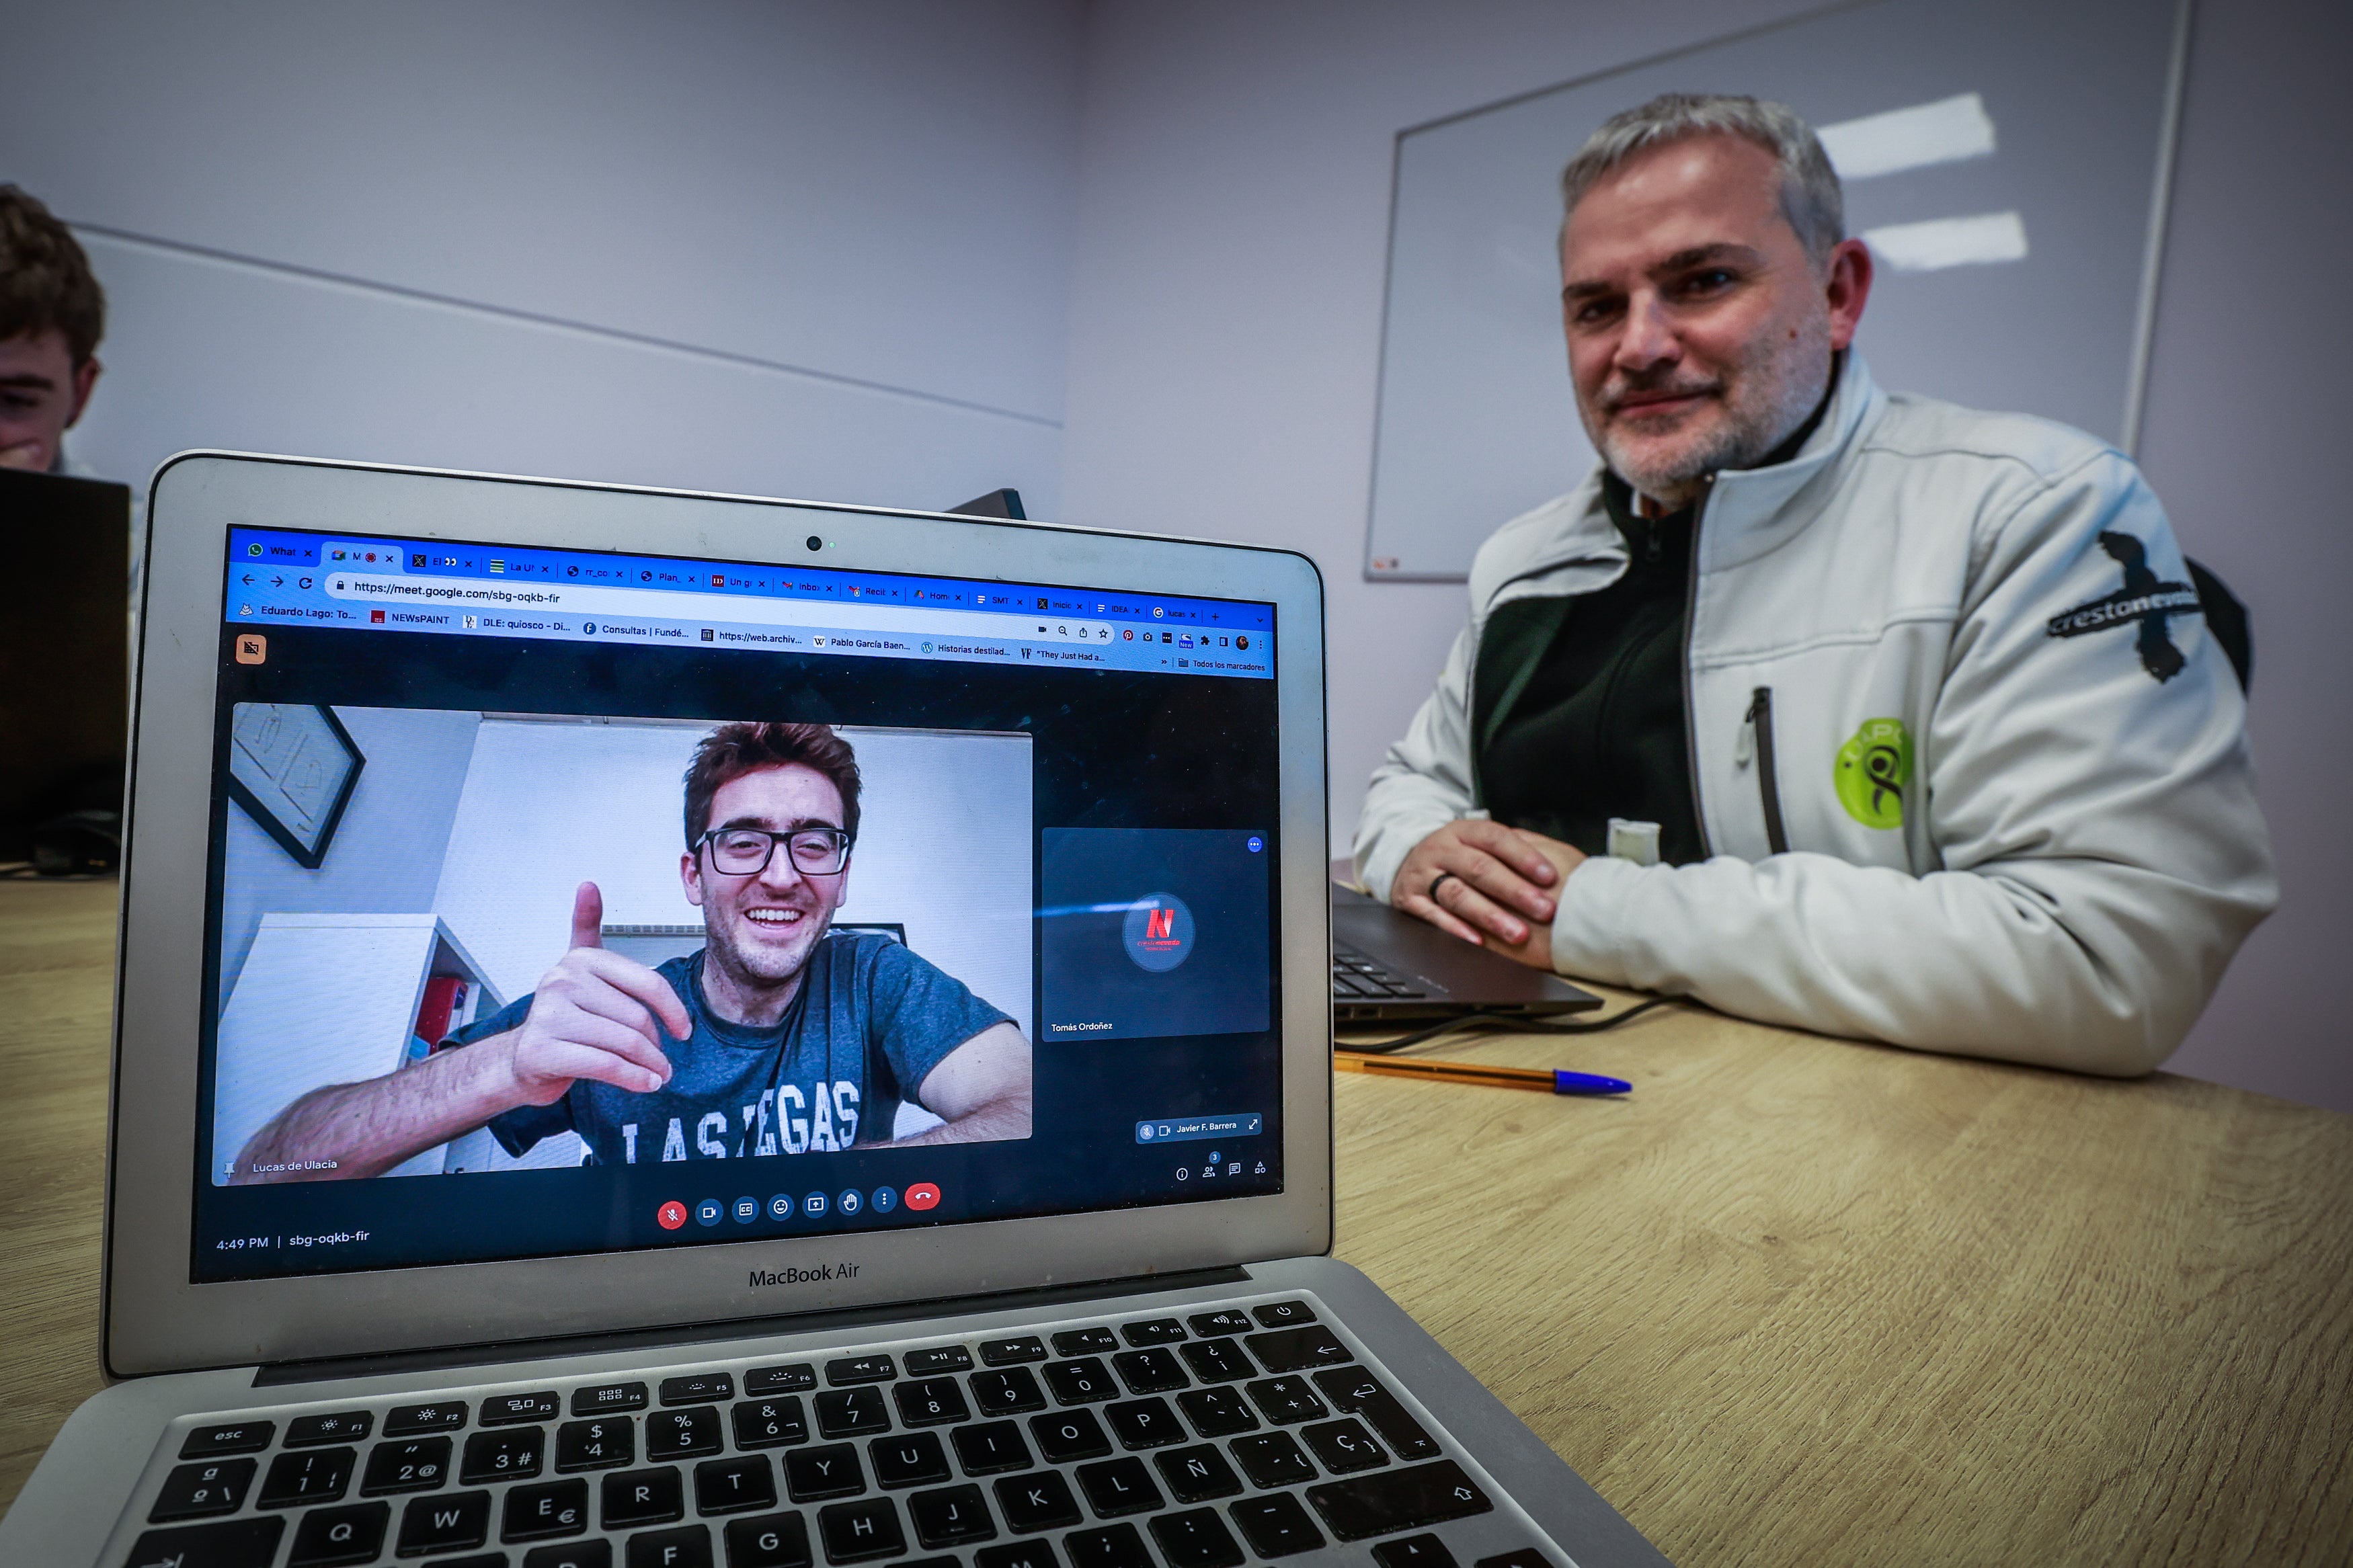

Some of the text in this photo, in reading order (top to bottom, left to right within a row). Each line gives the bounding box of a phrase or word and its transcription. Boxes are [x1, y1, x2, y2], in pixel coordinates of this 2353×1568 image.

[270, 546, 296, 556] What
[353, 552, 361, 561] M
[511, 563, 521, 571] La
[731, 578, 742, 586] Un
[354, 582, 560, 603] https://meet.google.com/sbg-oqkb-fir
[261, 606, 356, 619] Eduardo Lago: To...
[392, 614, 449, 624] NEWsPAINT
[1168, 610, 1185, 618] lucas
[483, 618, 504, 627] DLE:
[508, 620, 543, 630] quiosco
[553, 622, 570, 631] Di...
[602, 625, 647, 635] Consultas
[655, 628, 689, 638] Fundé...
[719, 632, 802, 645] https://web.archiv...
[831, 638, 910, 651] Pablo García Baen...
[938, 645, 1010, 656] Historias destilad...
[1061, 652, 1076, 660] Just
[1227, 663, 1265, 671] marcadores
[1051, 1022, 1113, 1032] Tomás Ordoñez
[1176, 1122, 1236, 1133] Javier F. Barrera
[253, 1159, 337, 1173] Lucas de Ulacia
[216, 1239, 245, 1251] 4:49
[249, 1237, 269, 1248] PM
[289, 1231, 370, 1247] sbg-oqkb-fir
[748, 1262, 861, 1288] MacBook Air
[1005, 1391, 1016, 1401] 9
[762, 1406, 776, 1417] &
[928, 1401, 940, 1412] 8
[675, 1415, 692, 1428] %
[848, 1411, 859, 1422] 7
[1138, 1414, 1150, 1426] P
[592, 1425, 602, 1438] $
[767, 1422, 778, 1434] 6
[215, 1432, 242, 1440] esc
[680, 1433, 691, 1445] 5
[1337, 1436, 1354, 1450] Ç
[591, 1444, 602, 1456] 4
[901, 1449, 918, 1463] U
[495, 1455, 508, 1468] 3
[817, 1461, 830, 1475] Y
[399, 1465, 436, 1479] 2 @
[1187, 1460, 1208, 1477] Ñ
[301, 1477, 307, 1491] 1
[728, 1474, 741, 1489] T
[1112, 1477, 1128, 1491] L
[636, 1487, 649, 1502] R
[1029, 1489, 1047, 1505] K
[539, 1499, 551, 1515] E
[949, 1504, 958, 1520] J
[435, 1510, 460, 1528] W
[558, 1510, 575, 1523] €
[330, 1524, 352, 1540] Q
[853, 1518, 873, 1536] H
[759, 1533, 778, 1550] G
[664, 1546, 676, 1565] F
